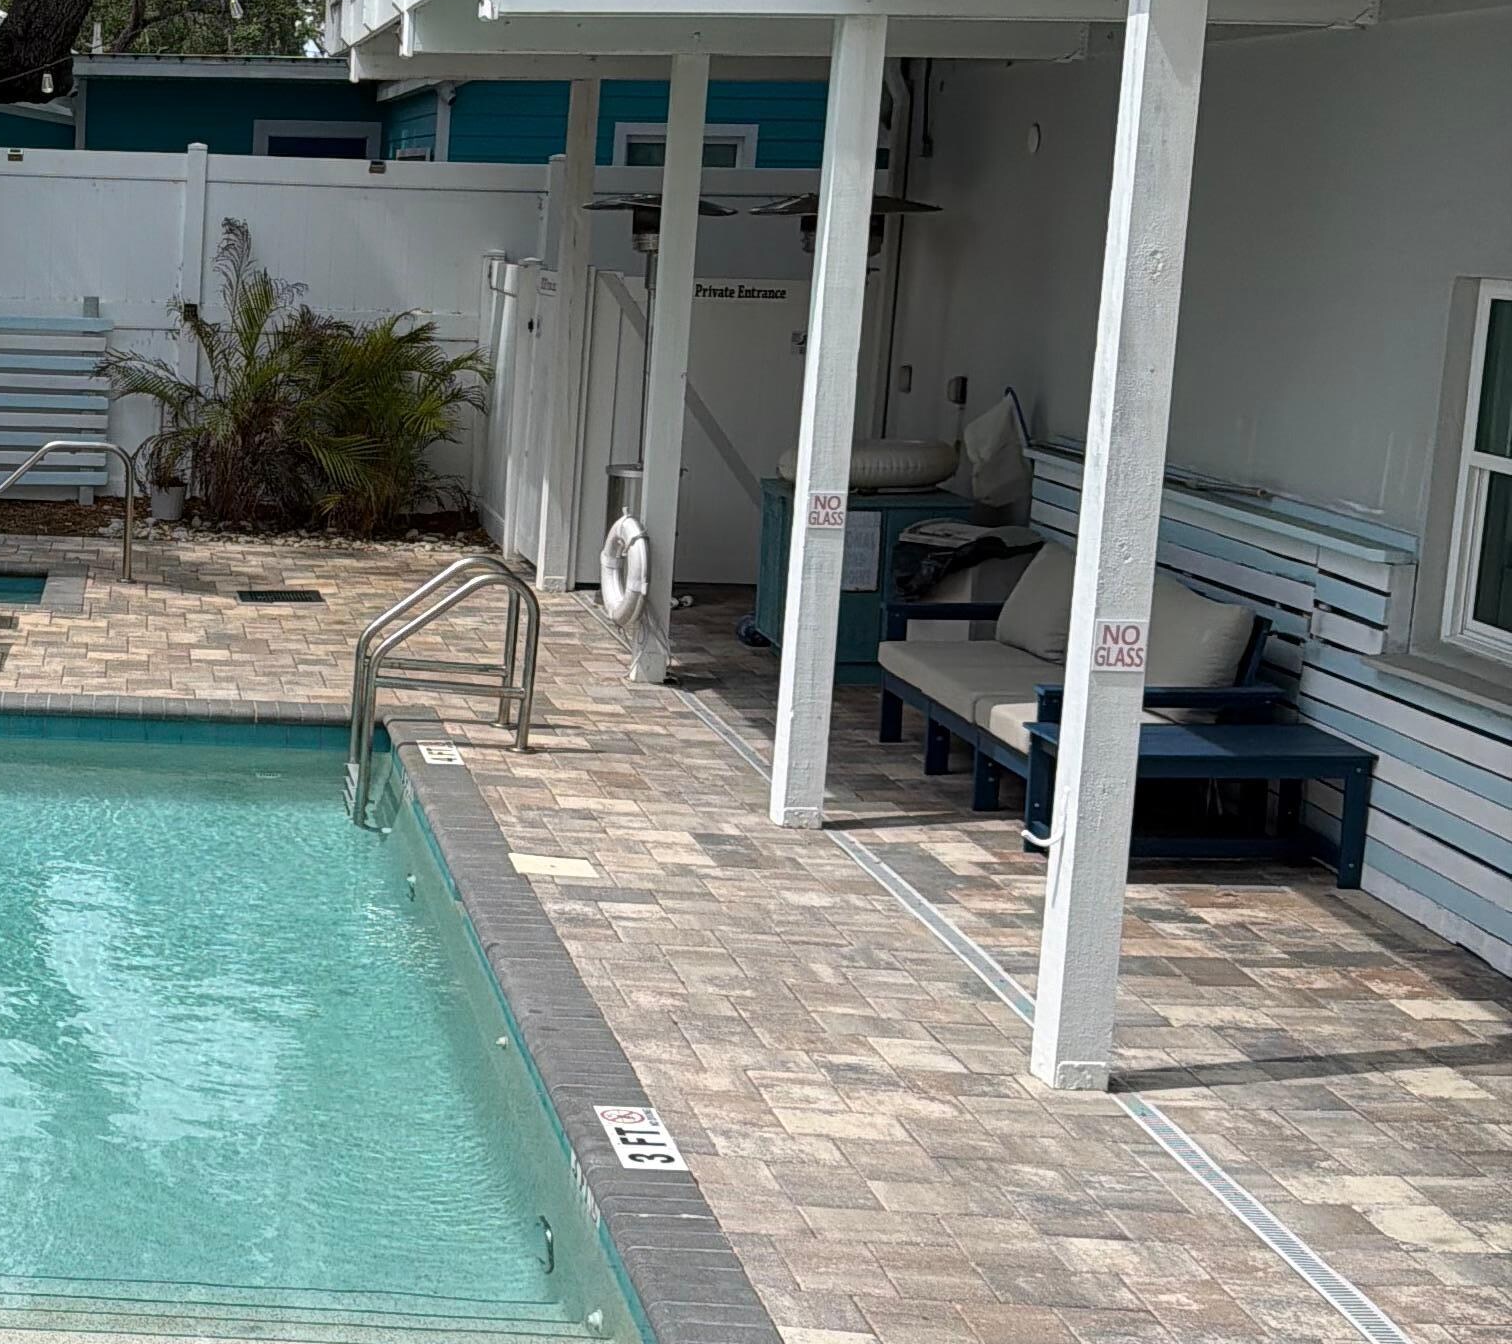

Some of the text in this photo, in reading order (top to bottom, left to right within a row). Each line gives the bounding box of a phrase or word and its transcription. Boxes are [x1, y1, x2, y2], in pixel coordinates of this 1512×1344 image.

[695, 284, 787, 299] Private Entrance
[814, 496, 841, 510] NO
[808, 511, 844, 526] GLASS
[1103, 624, 1140, 646] NO
[1095, 646, 1144, 667] GLASS
[614, 1127, 675, 1164] 3 FT
